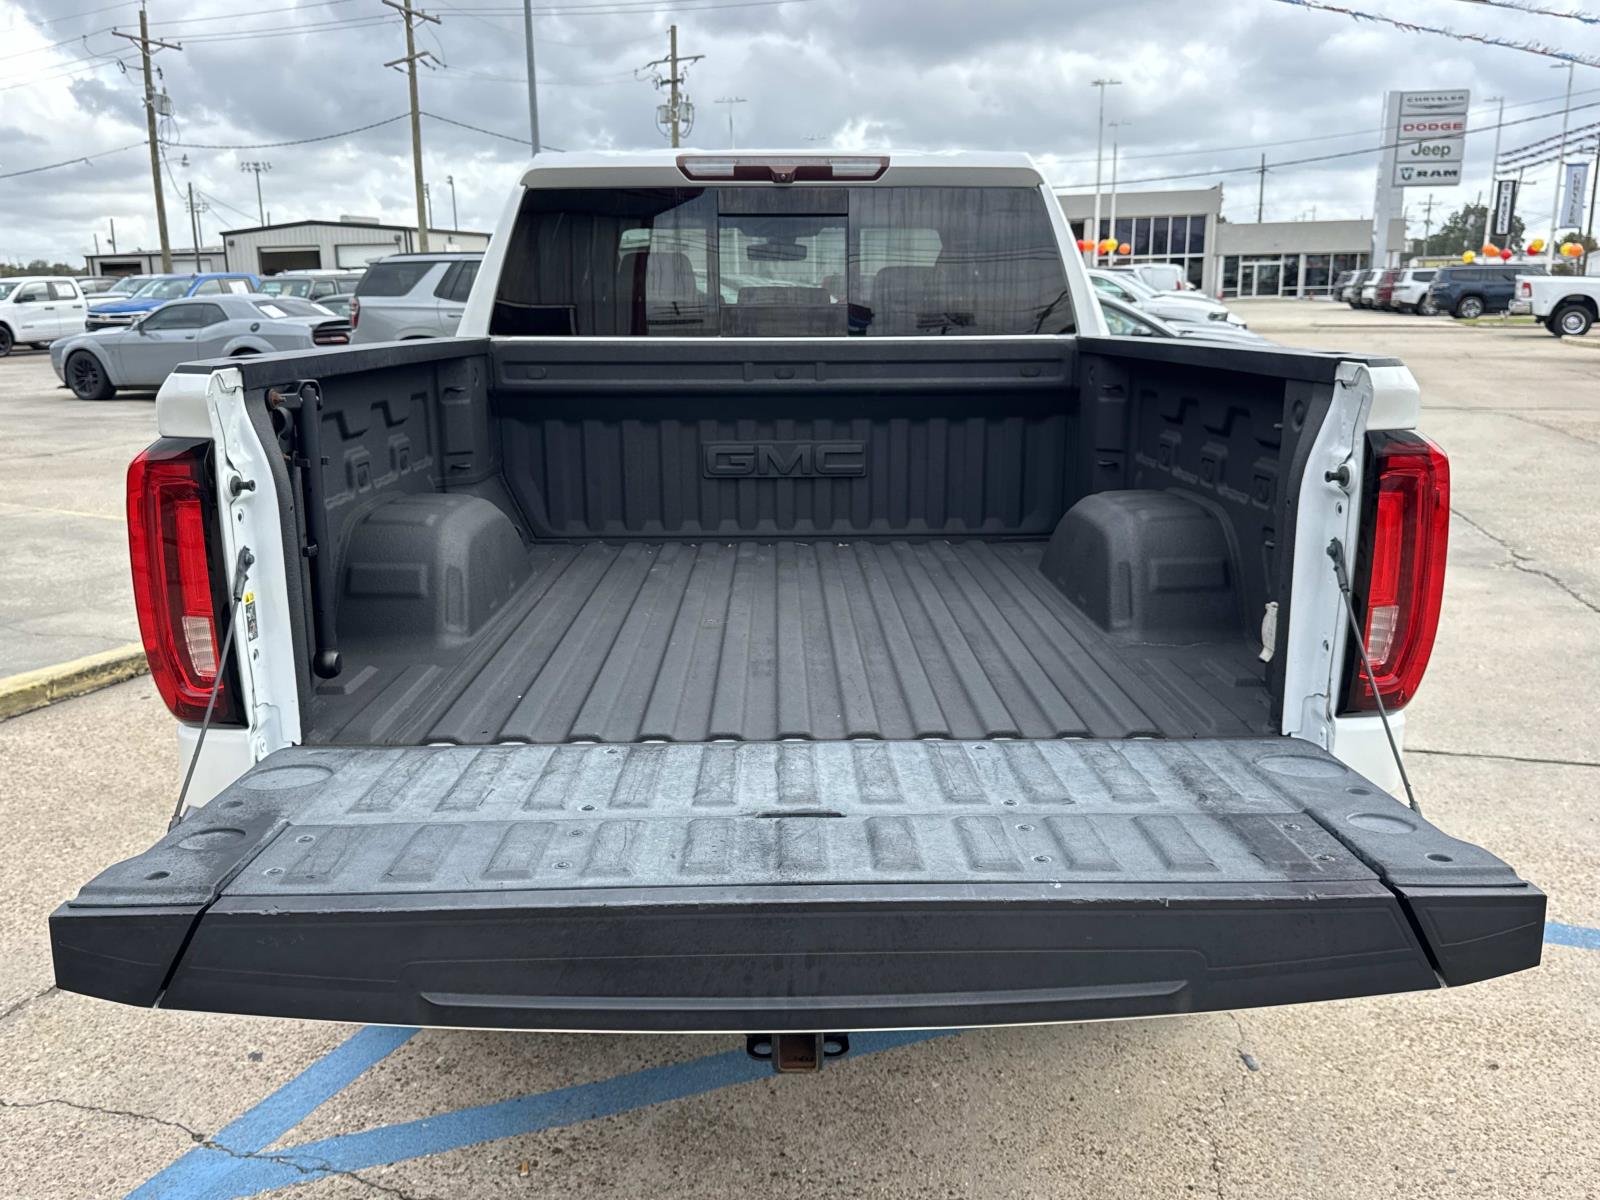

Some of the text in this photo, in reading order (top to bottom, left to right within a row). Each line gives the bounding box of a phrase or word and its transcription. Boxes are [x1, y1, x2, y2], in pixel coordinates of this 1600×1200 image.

[1403, 122, 1463, 131] DODGE
[1411, 139, 1451, 158] Jeep
[706, 444, 864, 475] GMC
